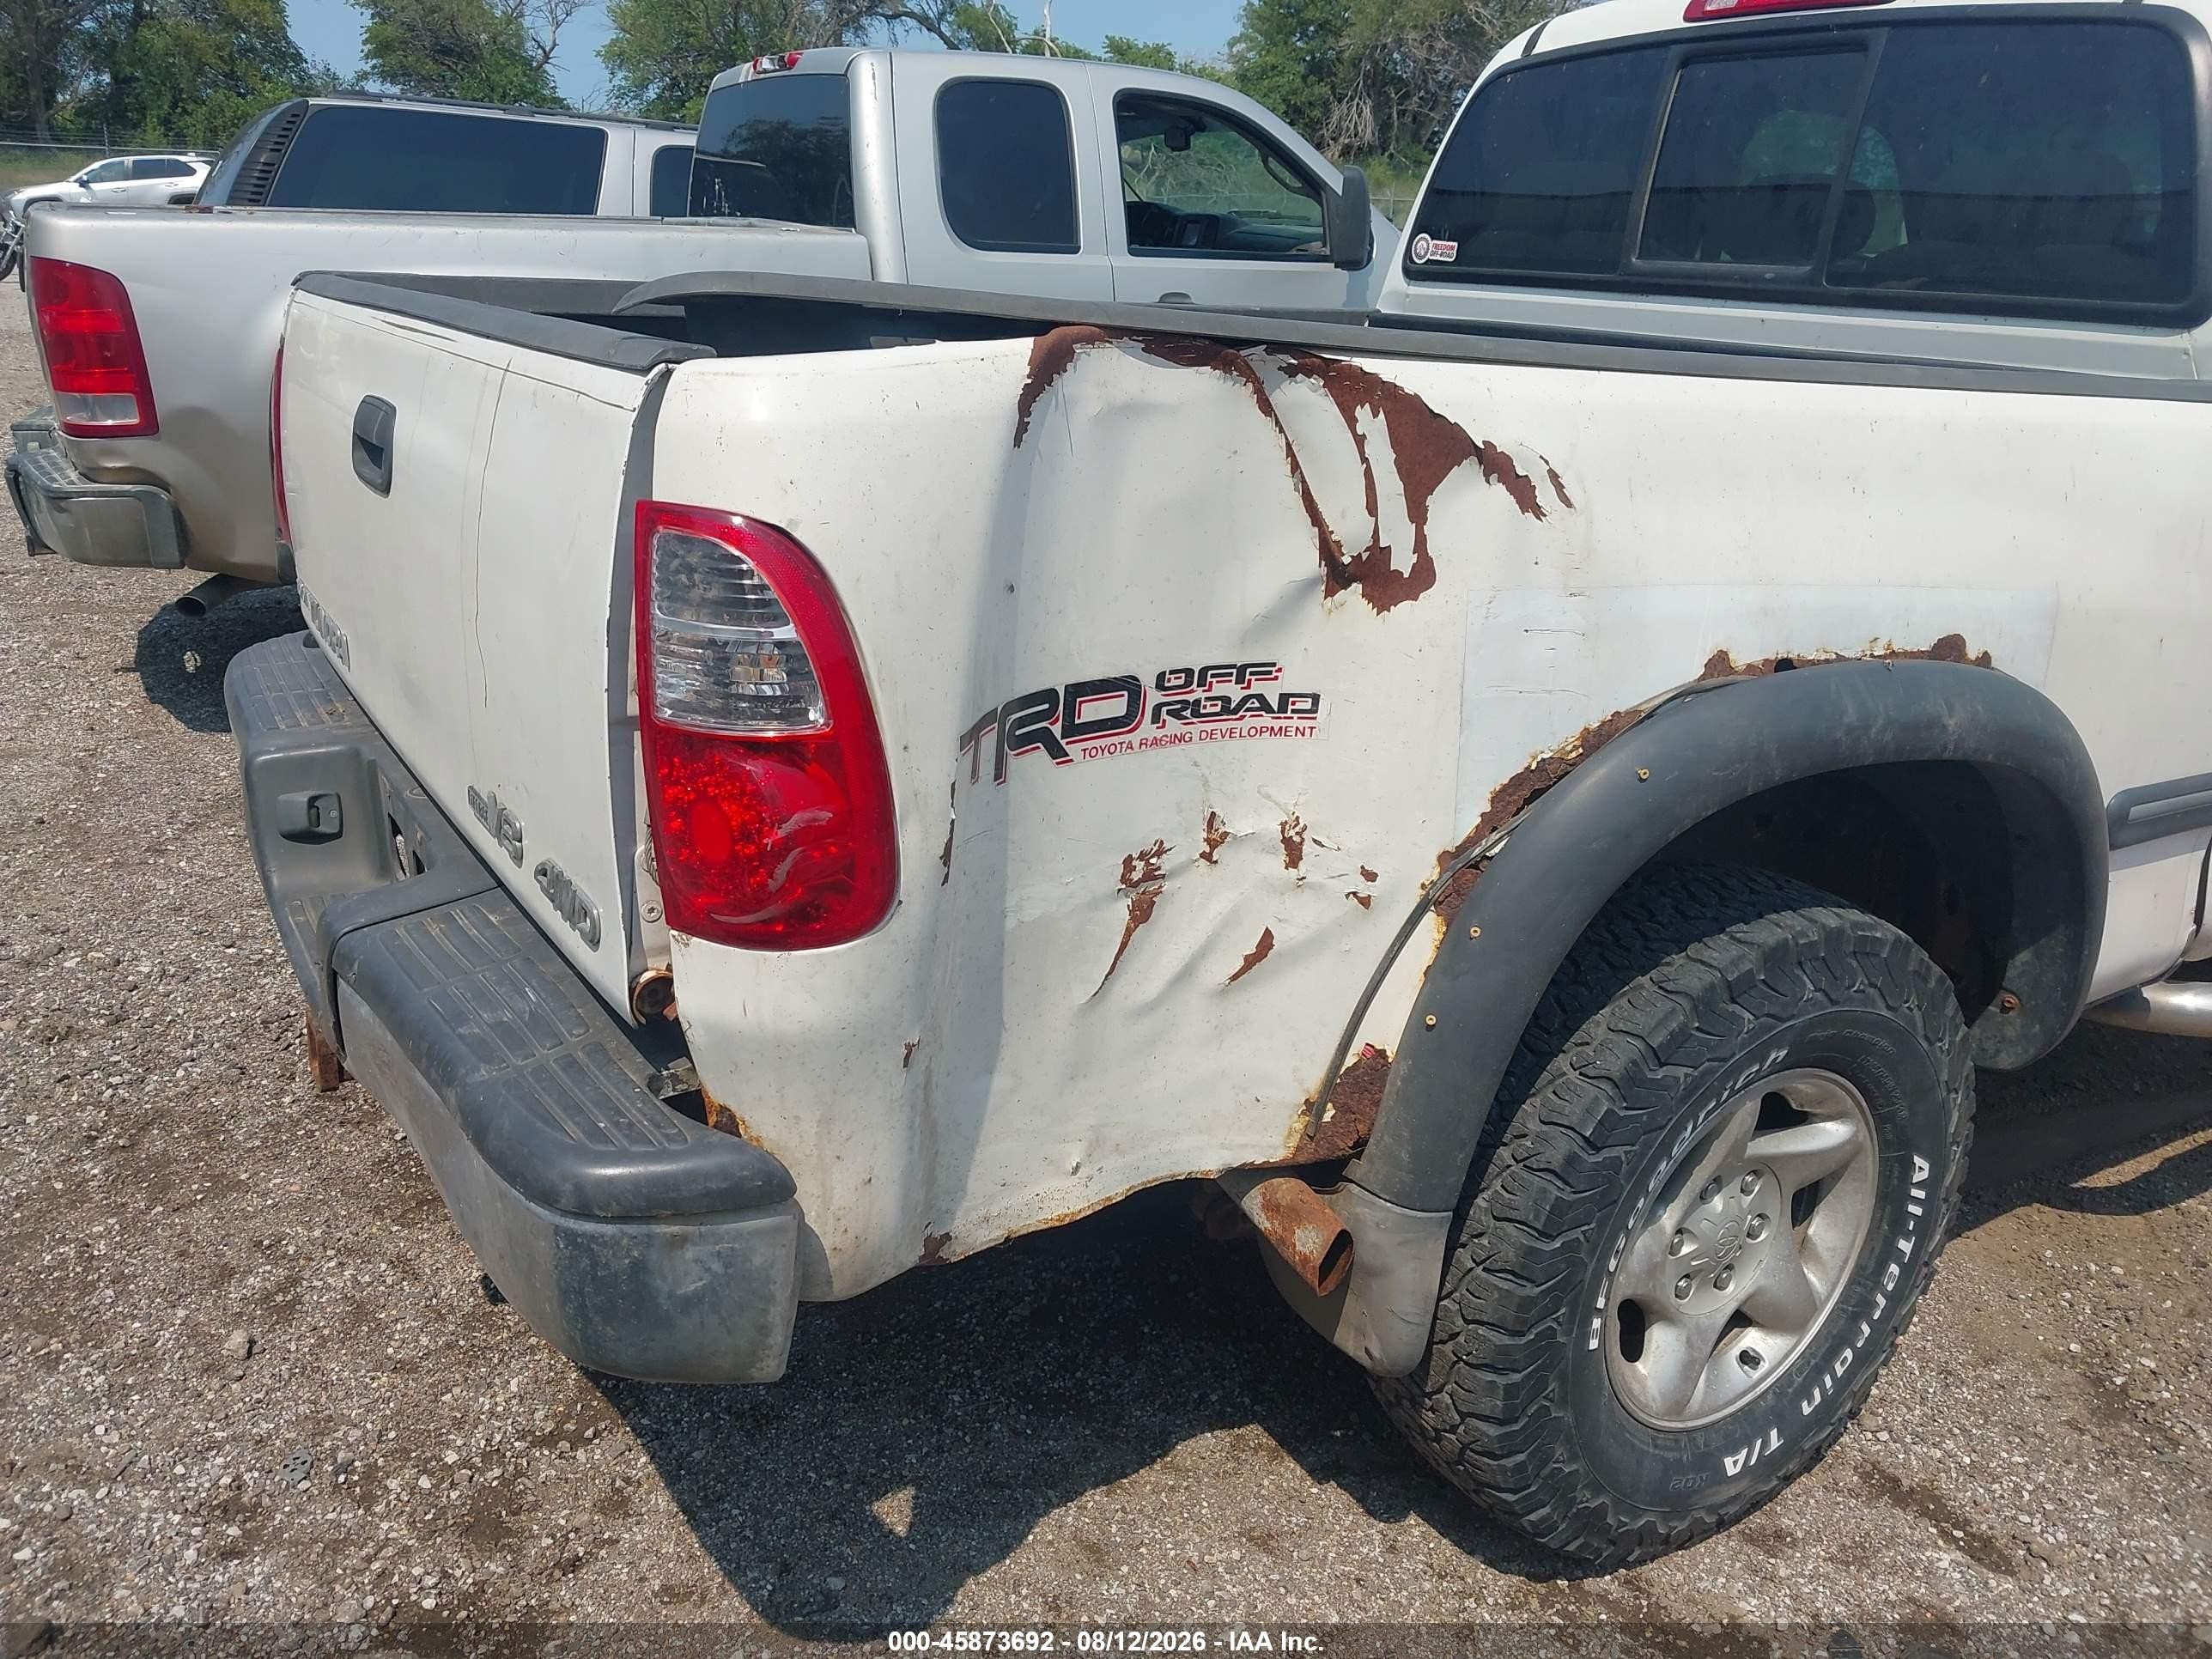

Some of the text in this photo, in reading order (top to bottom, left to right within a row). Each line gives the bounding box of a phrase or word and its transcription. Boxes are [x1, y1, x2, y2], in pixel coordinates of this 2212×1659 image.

[1429, 249, 1455, 259] OFF-ROAD
[1431, 242, 1455, 252] FREEDOM
[1155, 662, 1282, 697] OFF
[959, 675, 1146, 787] TRD
[1151, 692, 1322, 729] ROAD
[1080, 725, 1317, 760] TOYOTA RACING DEVELOPMENT
[533, 859, 602, 953] 4WD
[1588, 1047, 1790, 1351] BFGoodrich
[1802, 1154, 1931, 1416] All-Terrain
[1723, 1427, 1784, 1478] T/A
